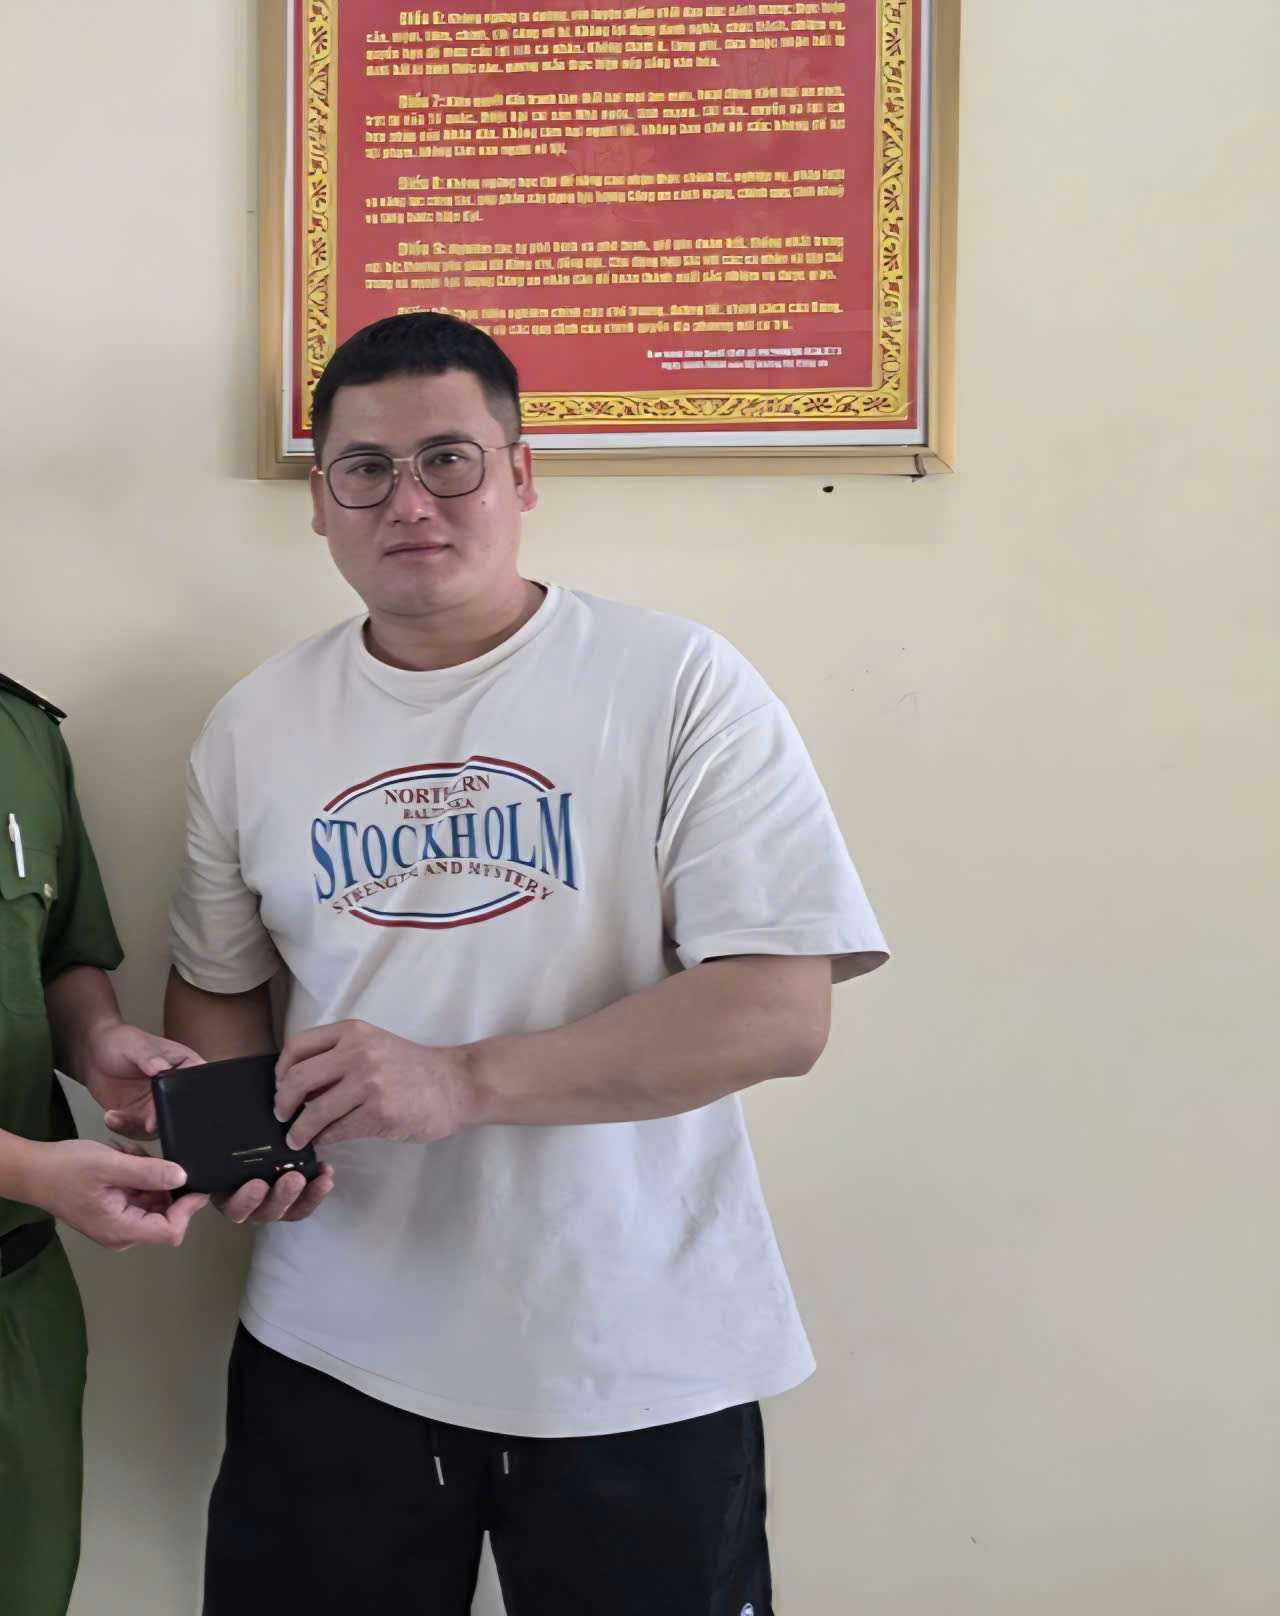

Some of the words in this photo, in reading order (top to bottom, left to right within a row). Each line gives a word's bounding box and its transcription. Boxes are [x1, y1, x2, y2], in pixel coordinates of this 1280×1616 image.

[383, 774, 491, 805] NORTRN
[310, 792, 580, 904] STOCKHOLM
[424, 860, 463, 877] AND
